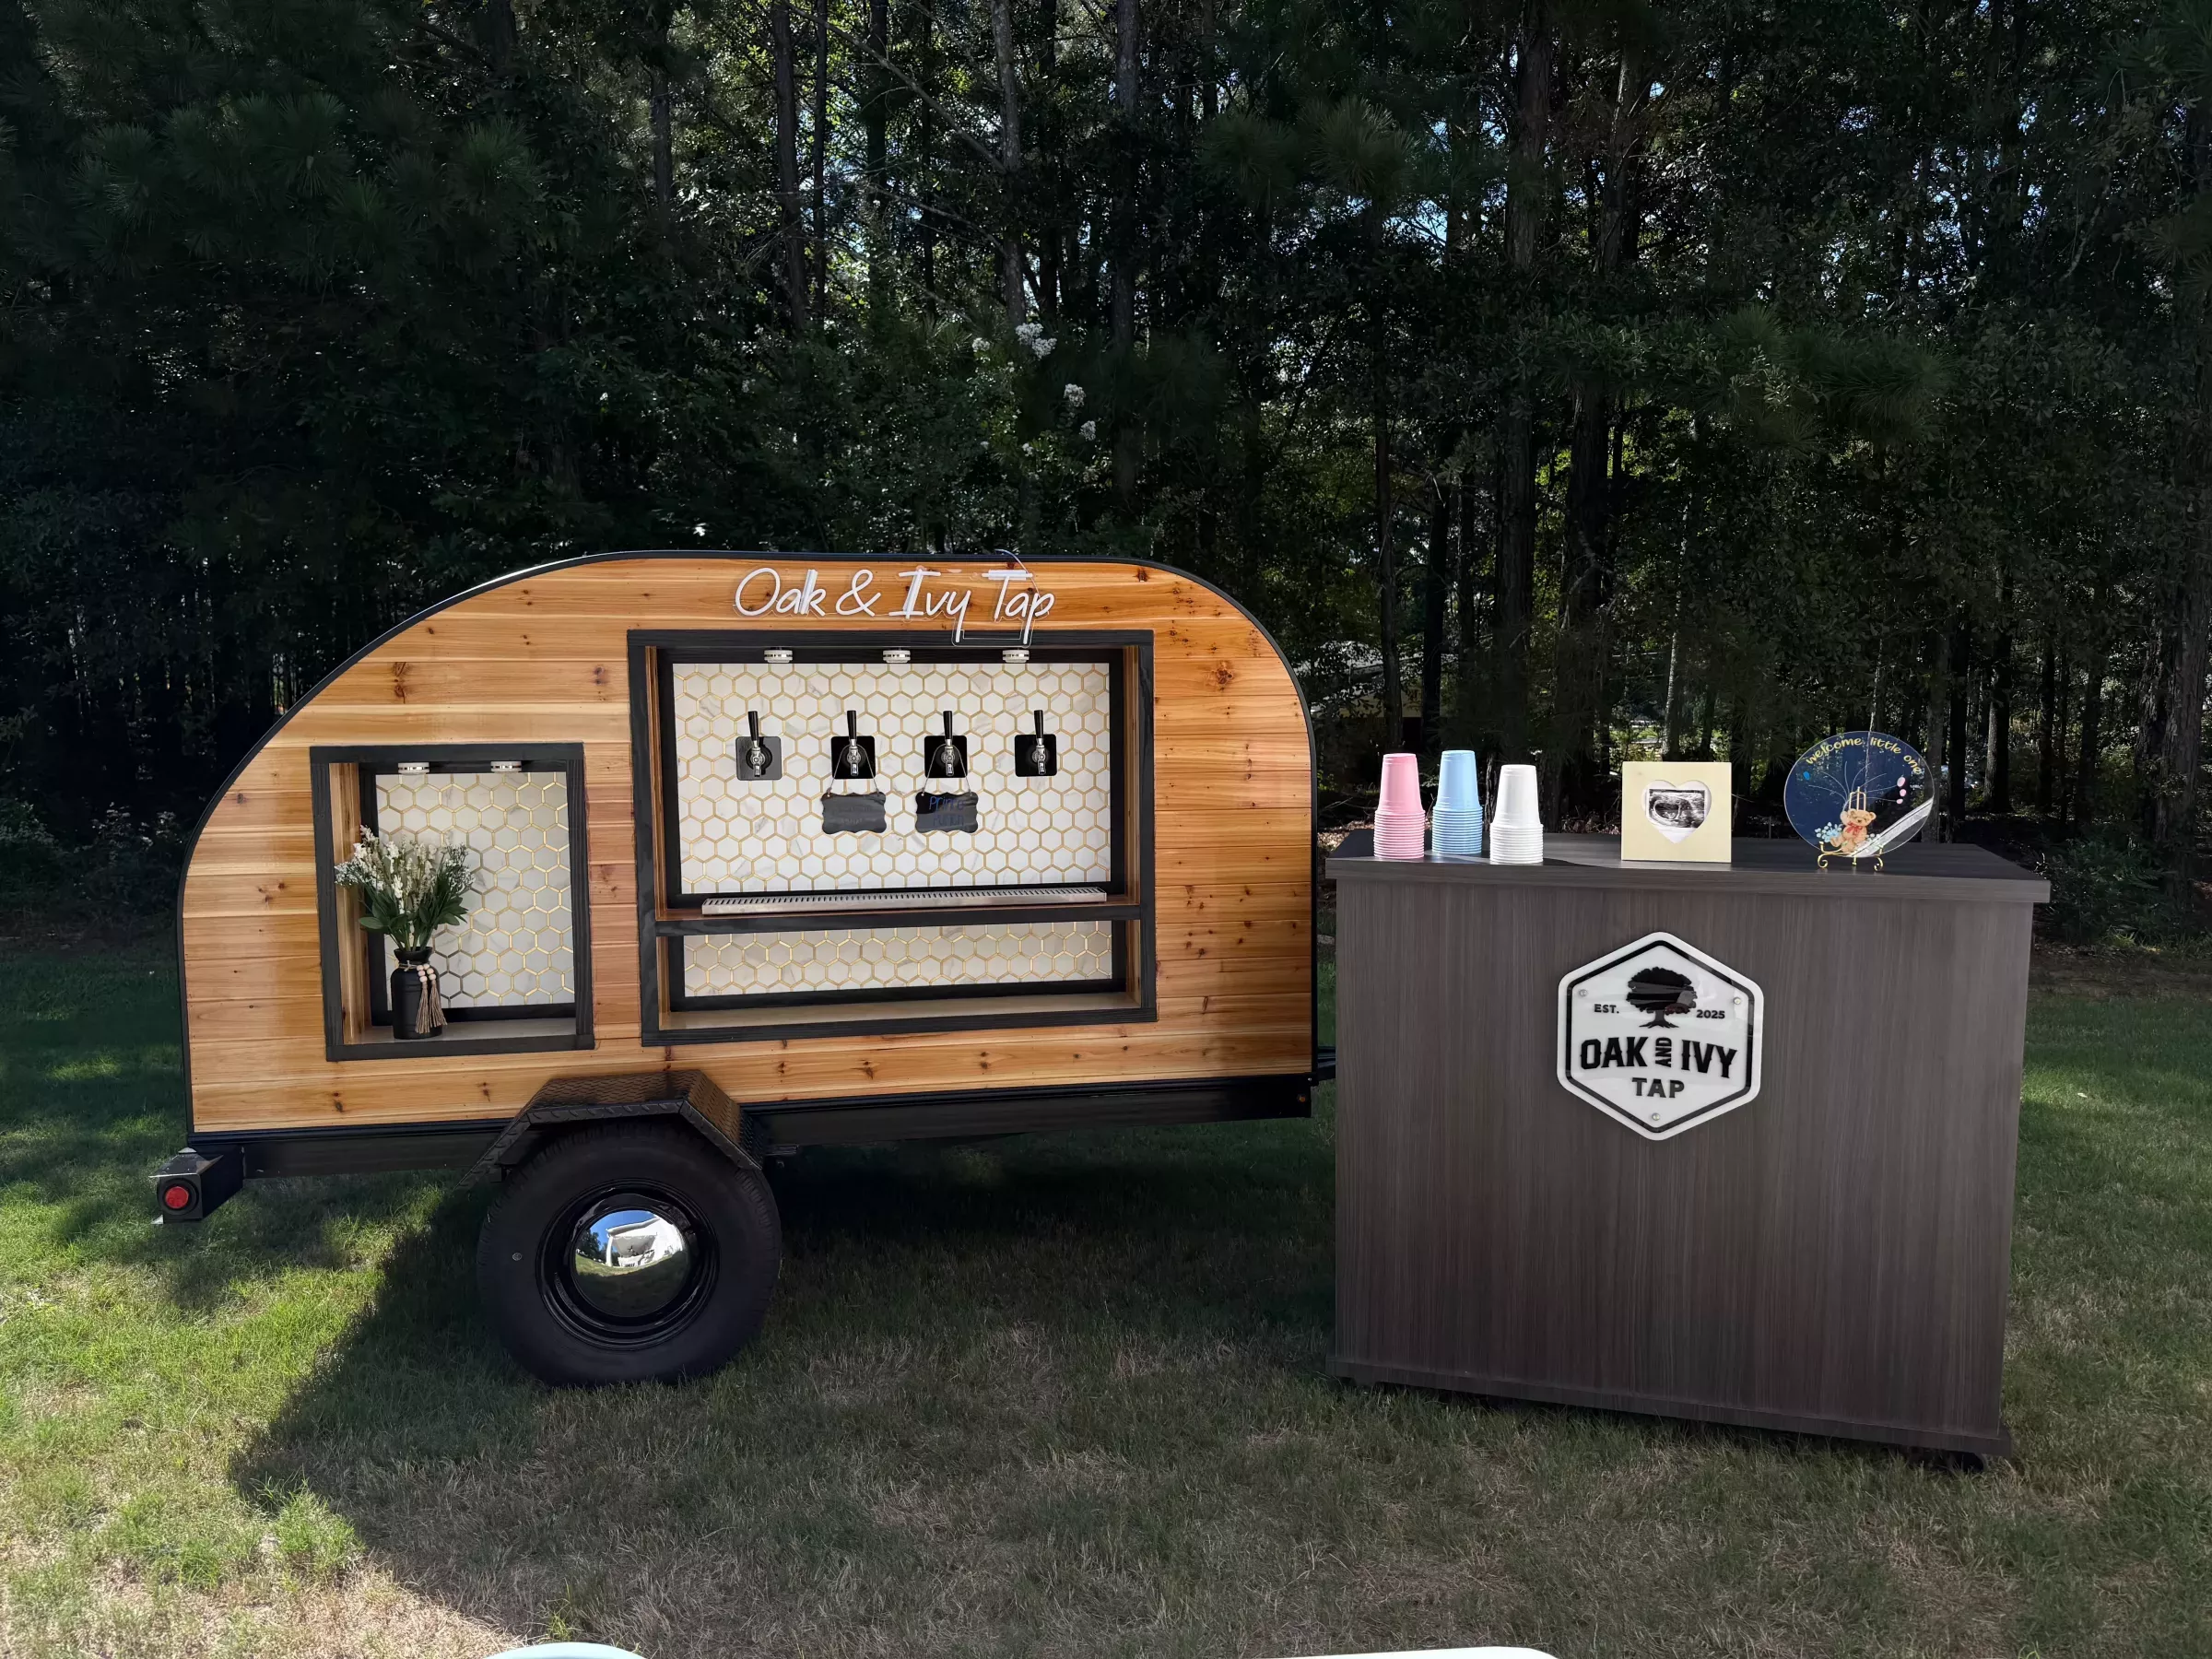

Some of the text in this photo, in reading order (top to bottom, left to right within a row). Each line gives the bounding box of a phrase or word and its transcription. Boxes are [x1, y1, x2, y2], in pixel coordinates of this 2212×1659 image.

[735, 567, 1055, 645] Oak & Ivy Tap
[1806, 736, 1924, 775] welcome little one
[1594, 1004, 1725, 1019] EST. 2025
[1580, 1036, 1738, 1079] OAK AND IVY
[1631, 1077, 1685, 1099] TAP
